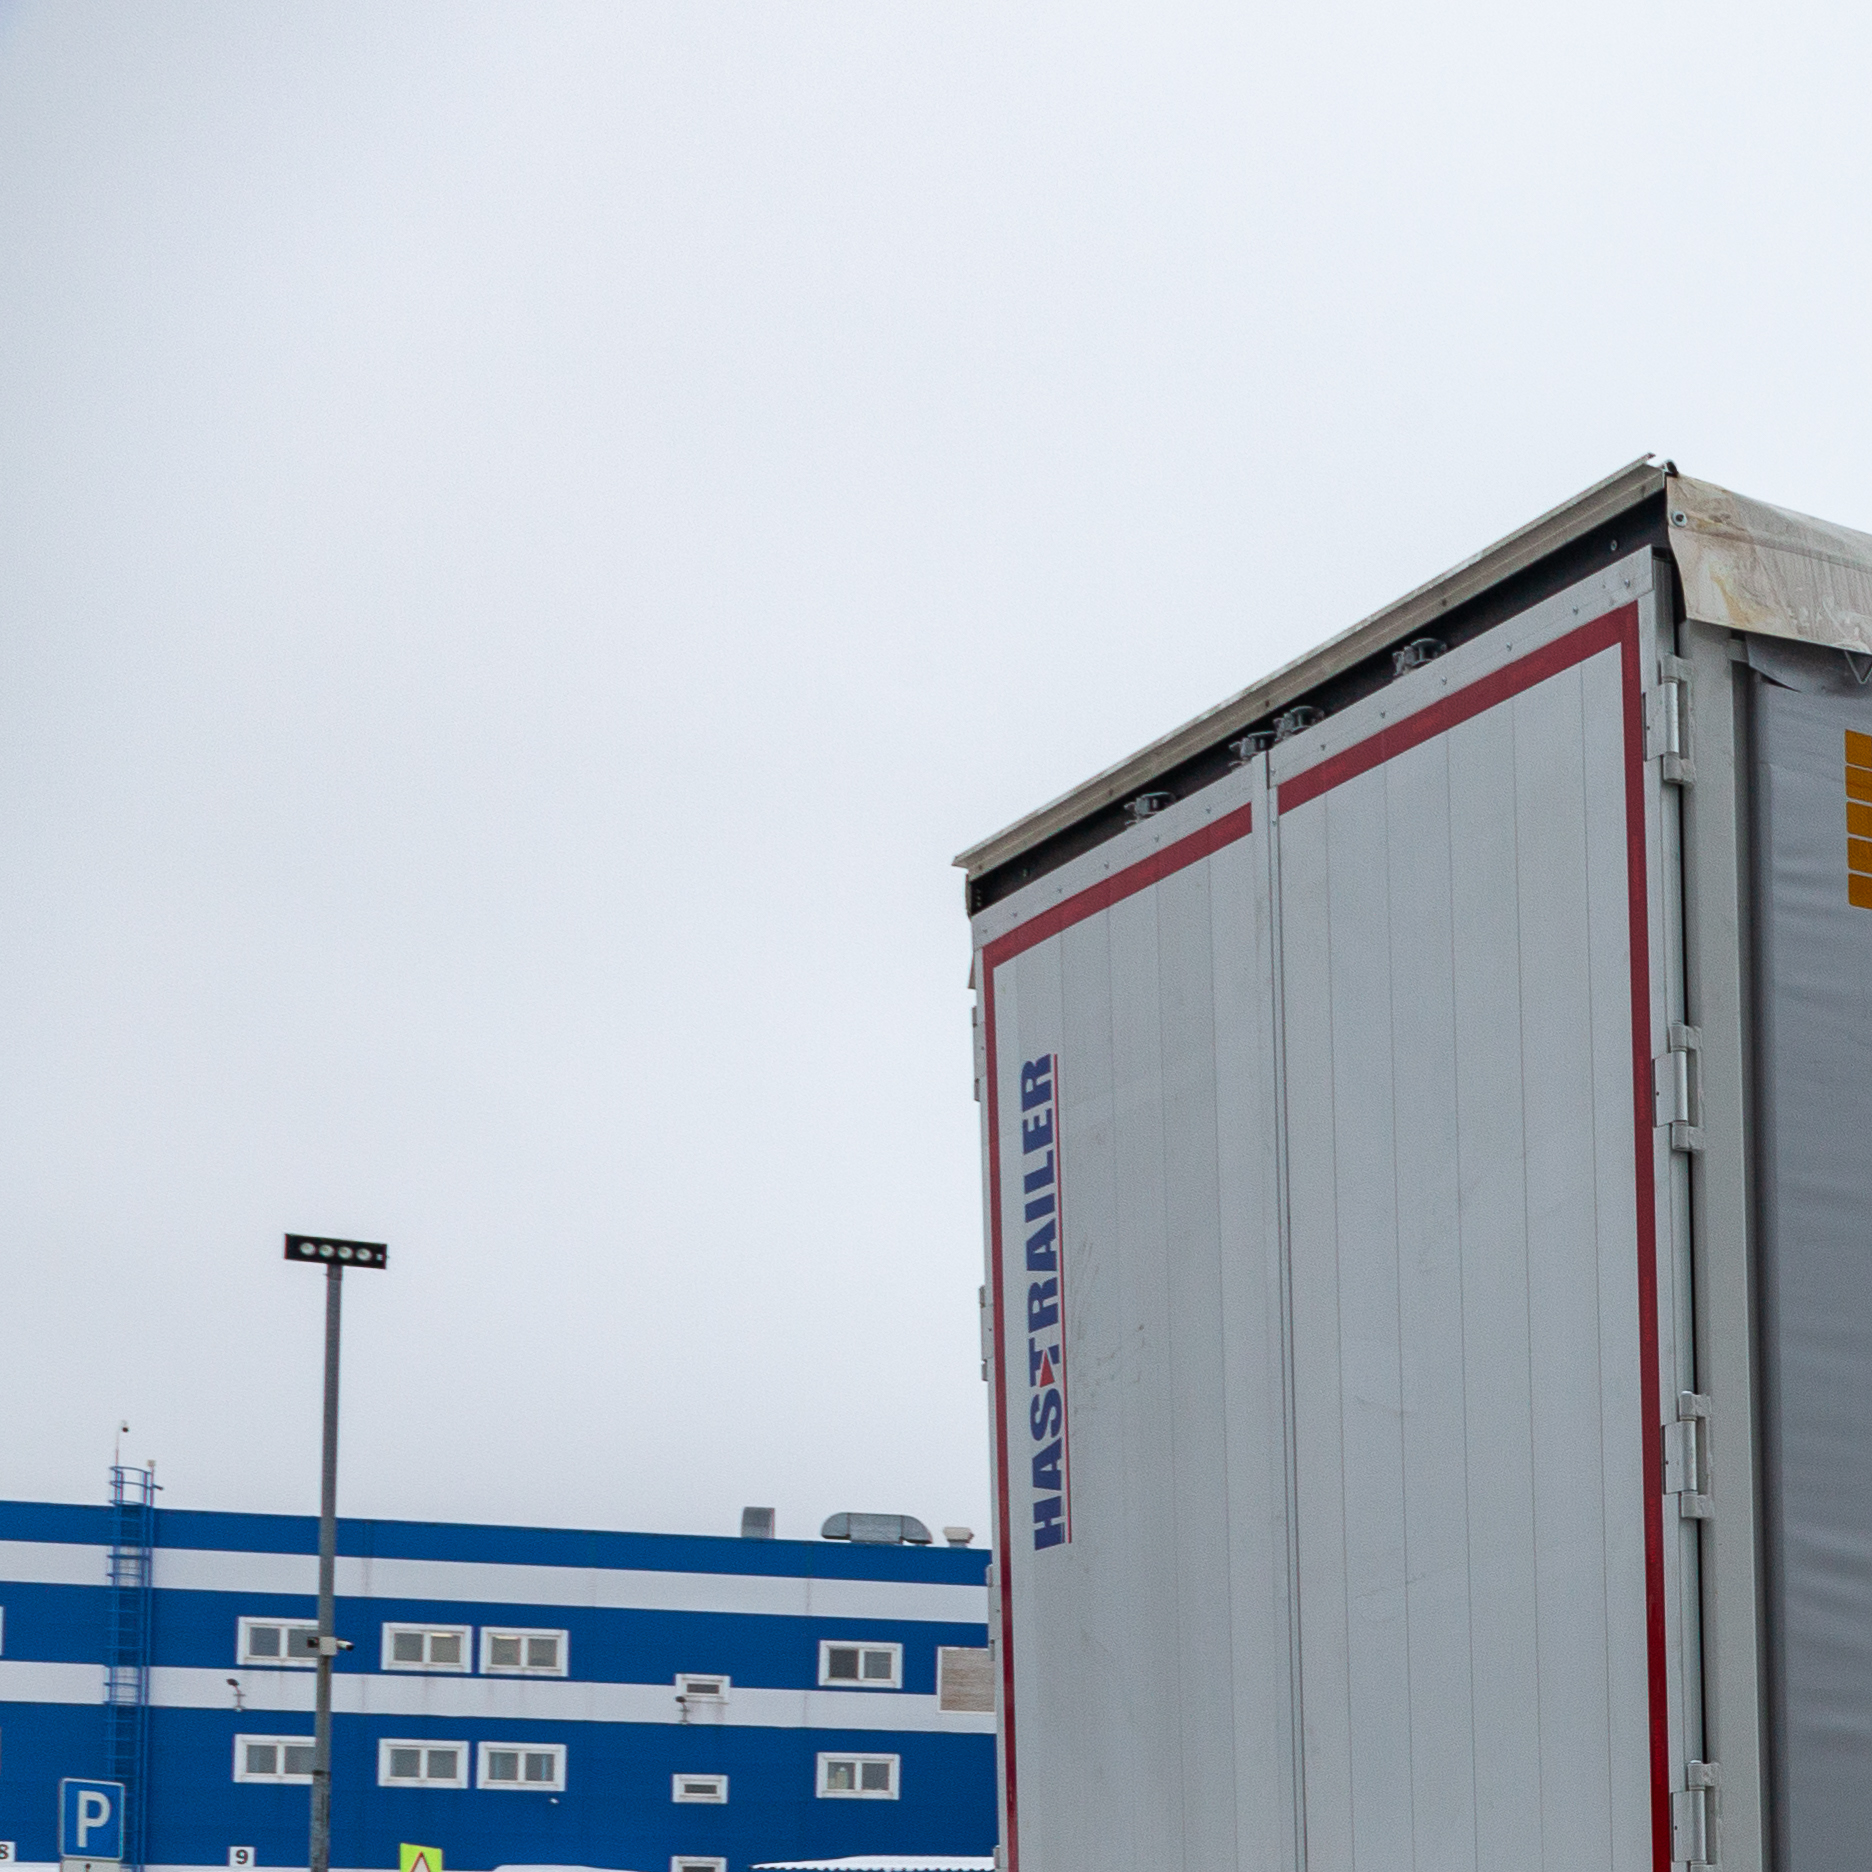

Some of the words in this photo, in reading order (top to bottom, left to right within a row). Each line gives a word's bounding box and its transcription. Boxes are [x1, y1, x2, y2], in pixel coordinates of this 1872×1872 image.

[1021, 1053, 1066, 1551] HASTRAILER
[77, 1790, 111, 1848] P
[235, 1849, 248, 1865] 9
